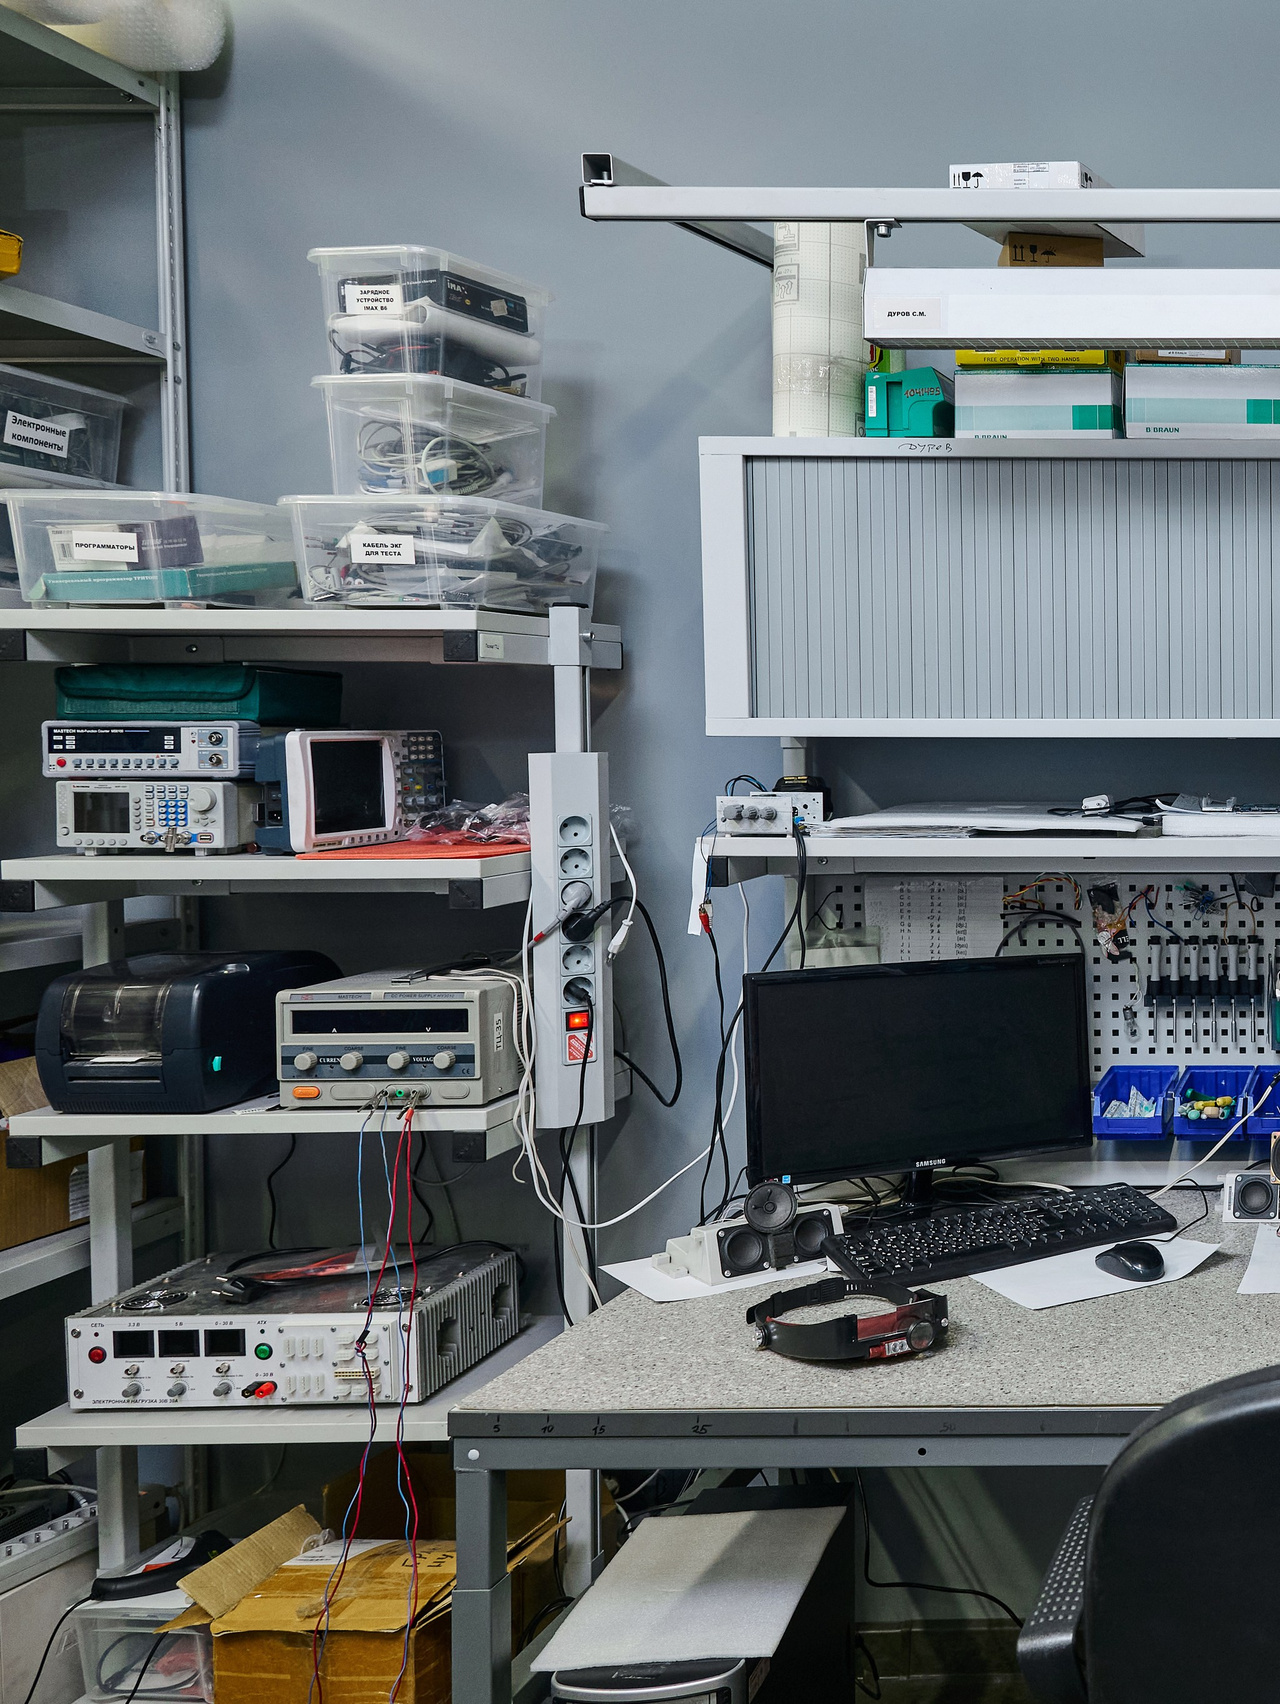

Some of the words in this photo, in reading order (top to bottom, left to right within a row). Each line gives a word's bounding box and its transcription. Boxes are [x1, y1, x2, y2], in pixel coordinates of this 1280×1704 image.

[11, 415, 67, 437] Электронные
[12, 432, 64, 451] компоненты
[75, 542, 135, 551] ПРОГРАММАТОРЫ
[915, 1158, 946, 1167] SAMSUNG
[493, 1424, 500, 1433] 5
[541, 1424, 554, 1433] 10
[592, 1425, 605, 1435] 15
[692, 1424, 713, 1434] 25
